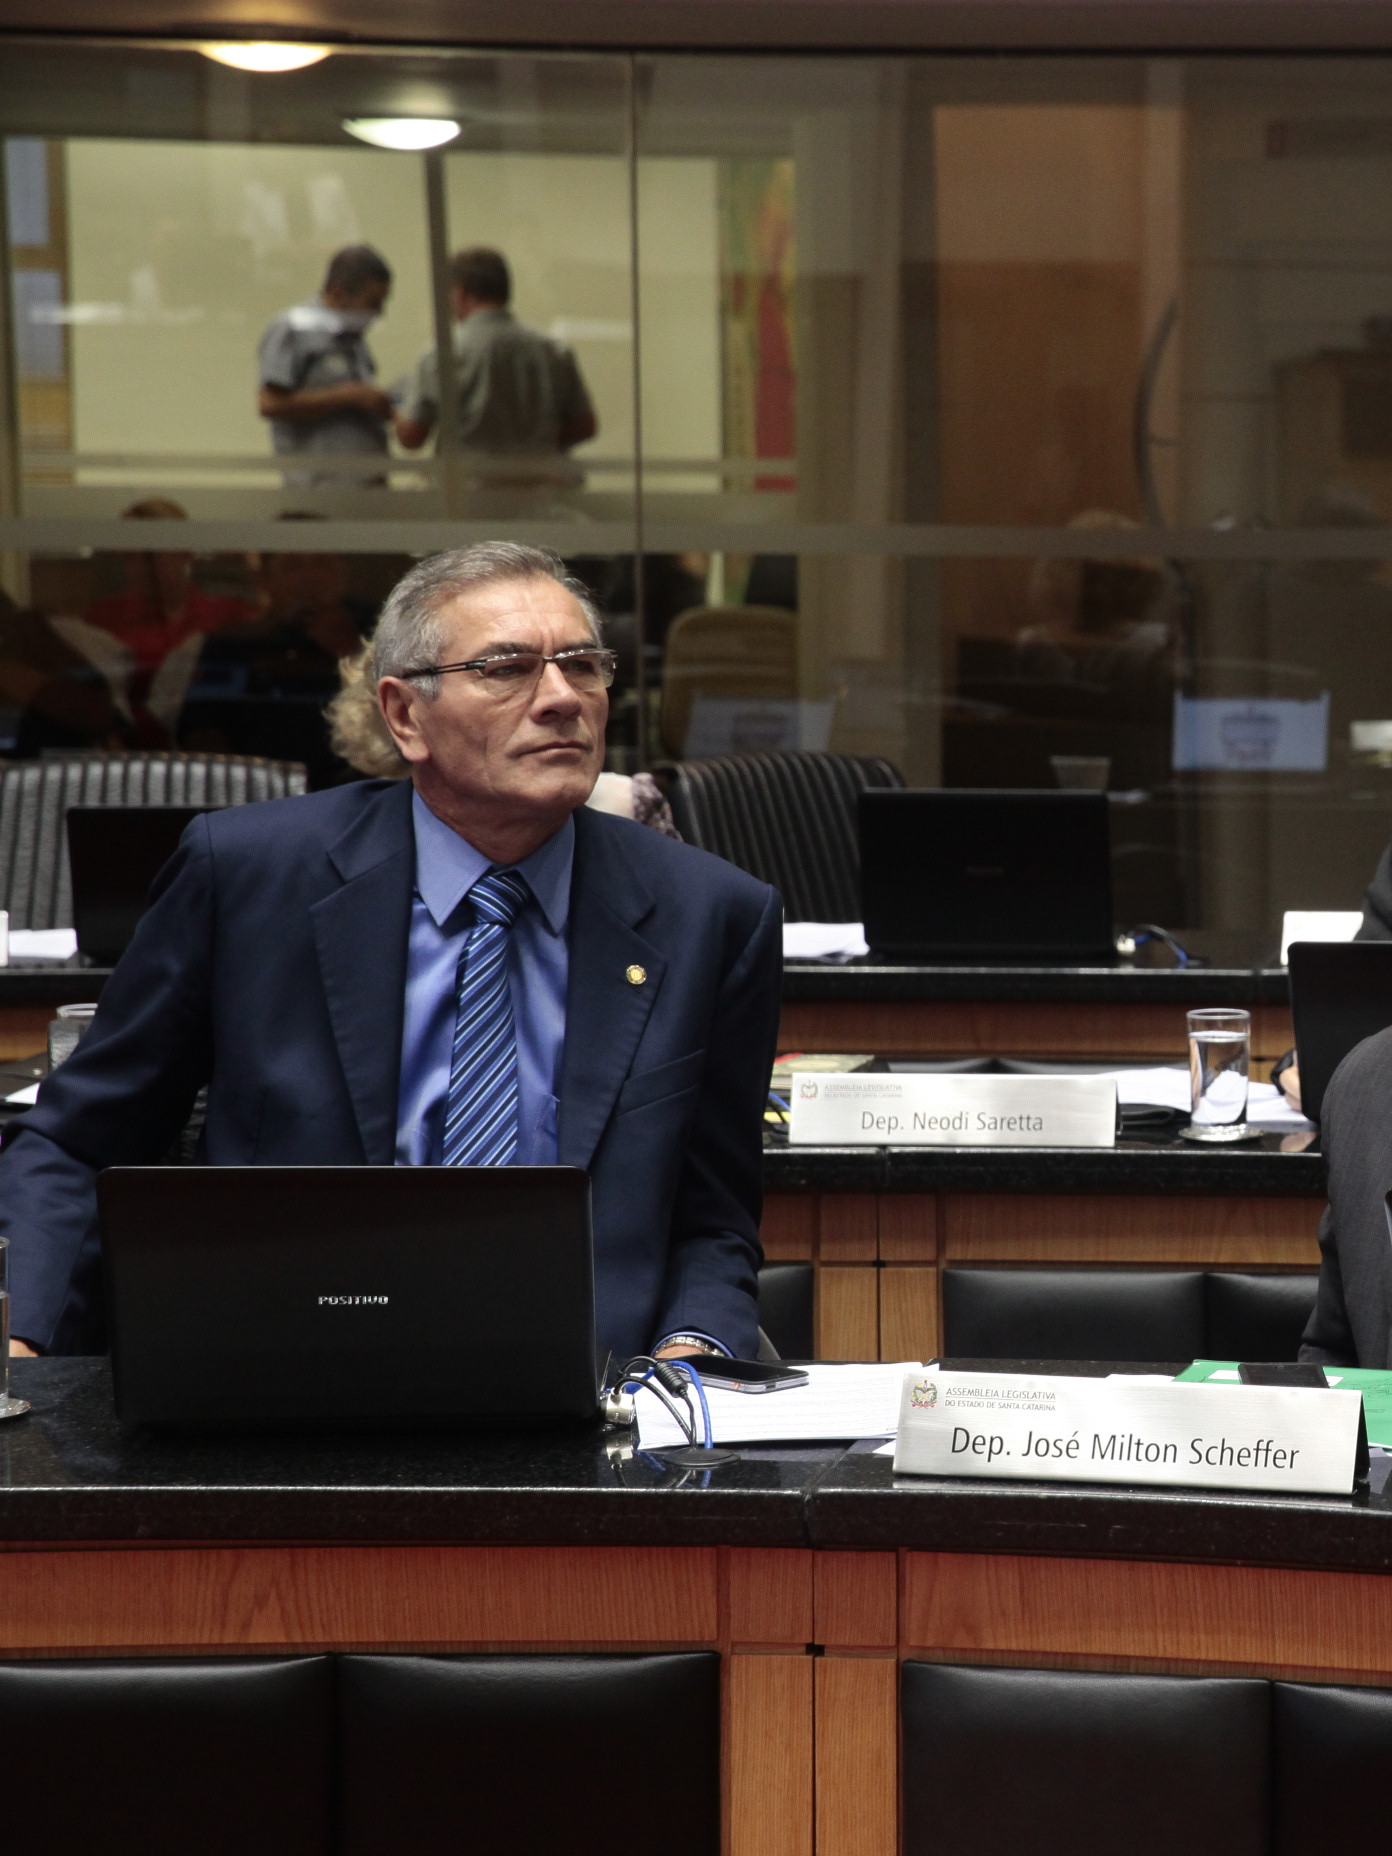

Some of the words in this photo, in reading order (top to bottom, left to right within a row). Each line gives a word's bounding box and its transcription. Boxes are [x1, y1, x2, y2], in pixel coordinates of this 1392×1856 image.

[861, 1111, 904, 1134] Dep.
[913, 1111, 969, 1131] Neodi
[977, 1112, 1043, 1132] Saretta
[318, 1295, 389, 1305] POSITIVO
[946, 1387, 999, 1398] ASSEMBLEIA
[1001, 1389, 1056, 1400] LEGISLATIVA
[945, 1399, 955, 1407] DO
[958, 1400, 984, 1408] ESTADO
[986, 1401, 996, 1409] DE
[998, 1402, 1020, 1410] SANTA
[1022, 1403, 1056, 1412] CATARINA
[951, 1426, 1011, 1461] Dep.
[1021, 1431, 1080, 1459] José
[1091, 1433, 1178, 1464] Milton
[1189, 1438, 1300, 1469] Scheffer
